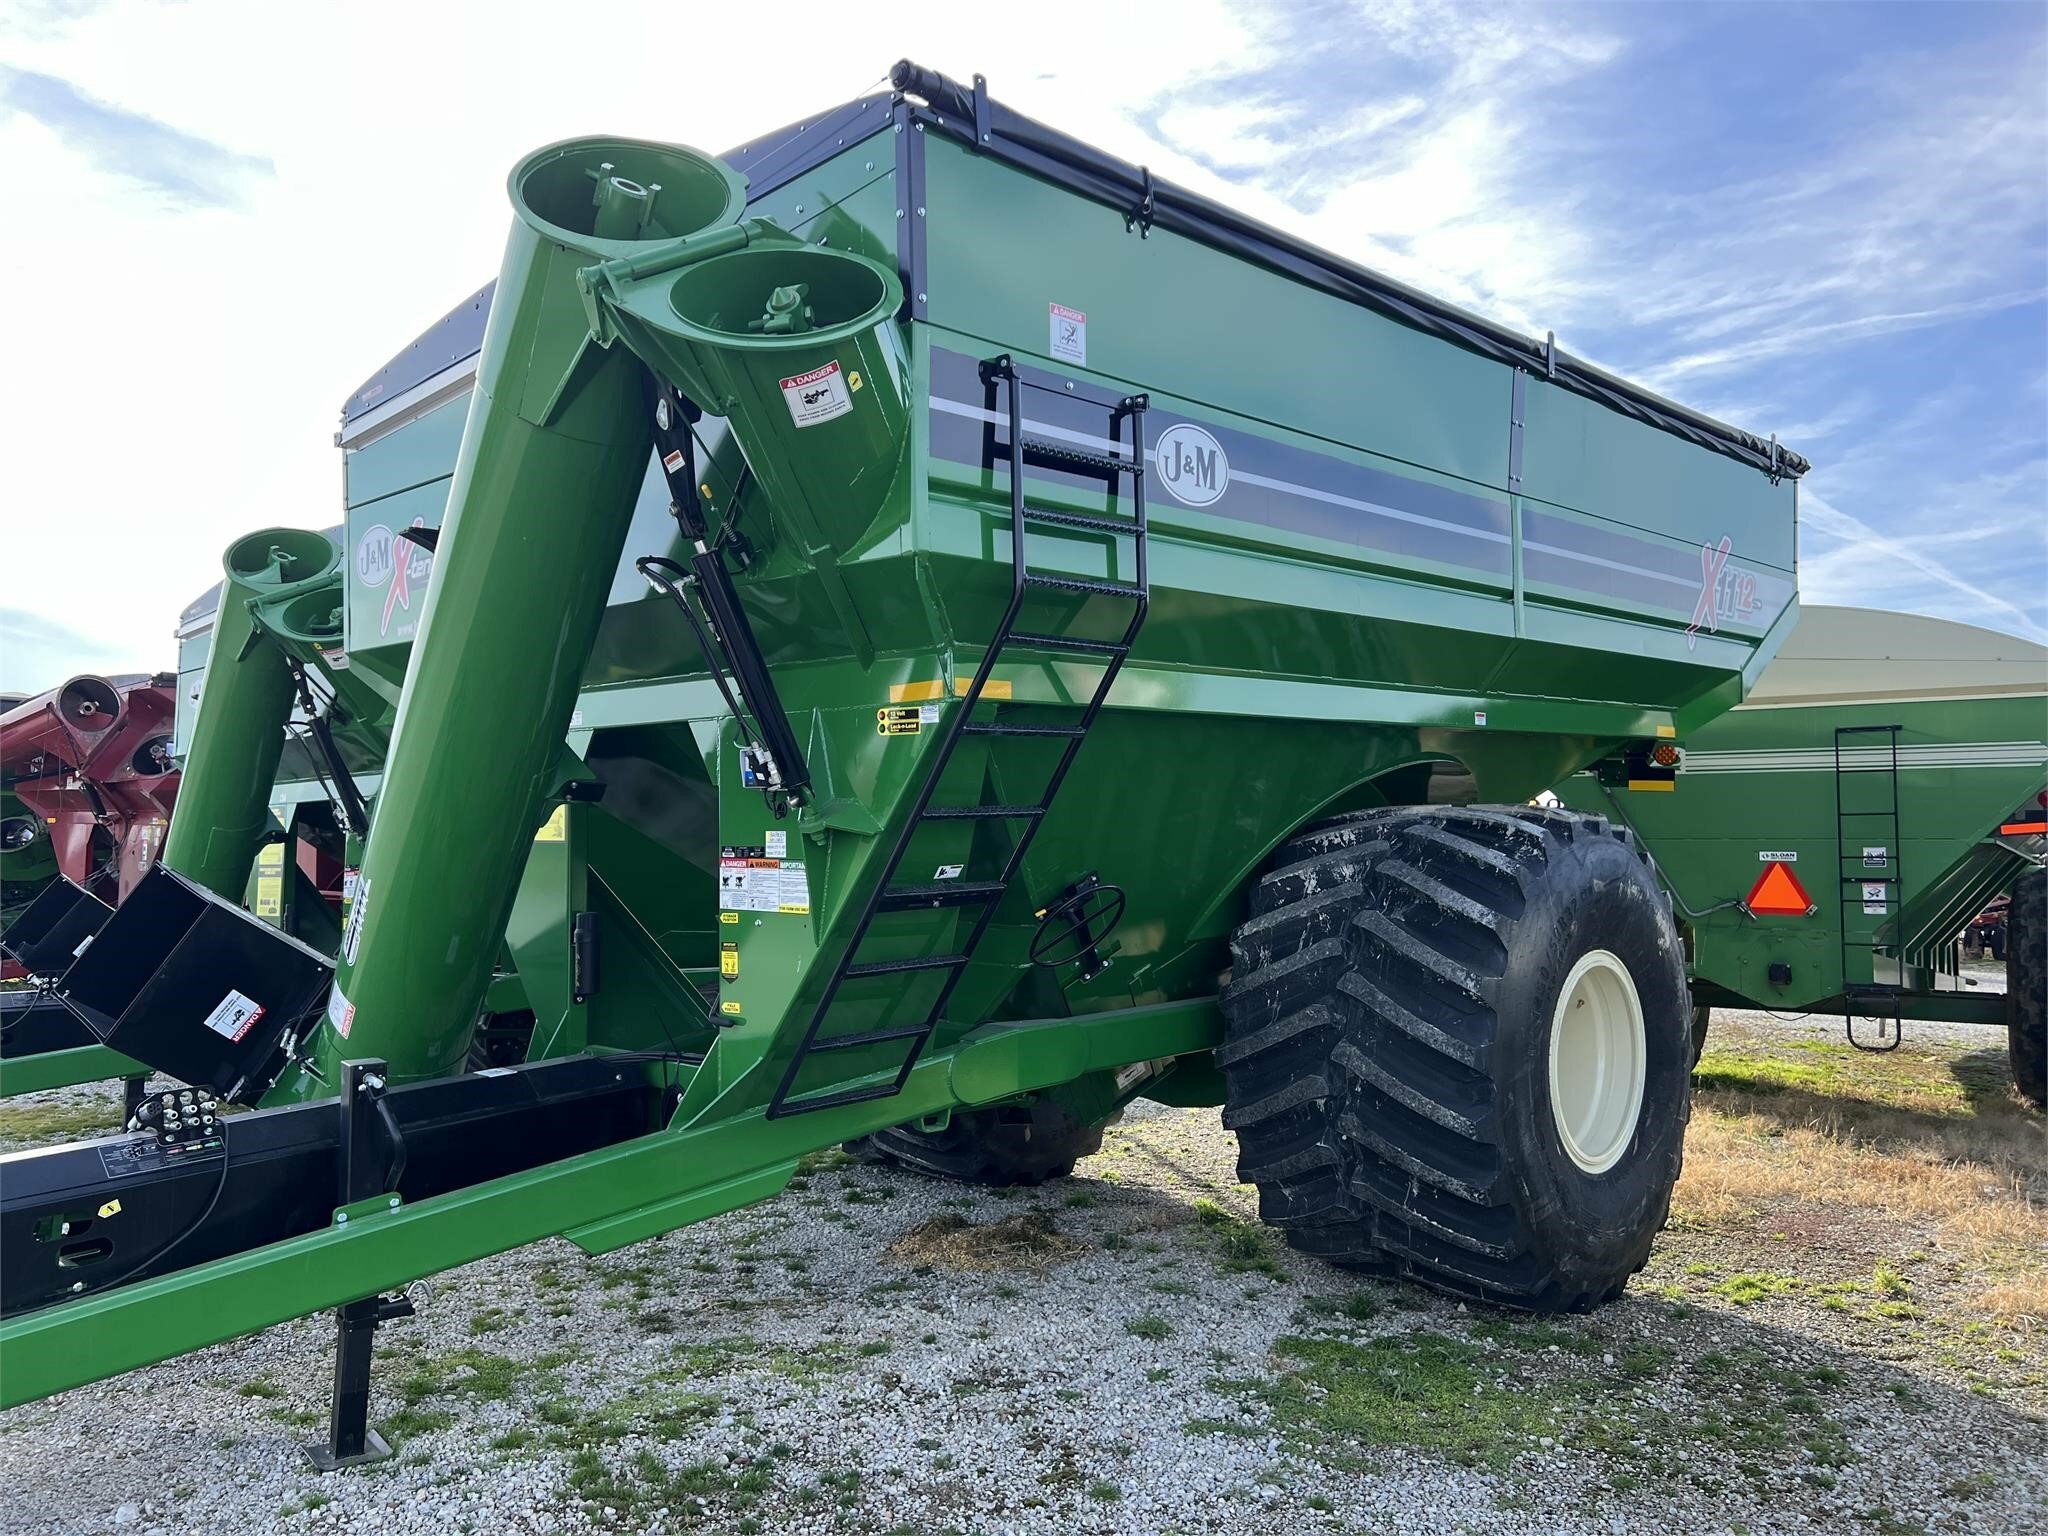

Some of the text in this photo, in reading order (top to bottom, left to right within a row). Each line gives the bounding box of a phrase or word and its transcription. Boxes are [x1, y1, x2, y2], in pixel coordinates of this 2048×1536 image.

[796, 365, 834, 385] DANGER
[1163, 440, 1217, 491] J&M
[360, 536, 389, 576] J&M
[725, 860, 748, 868] DANGER
[233, 1013, 260, 1042] DANGER
